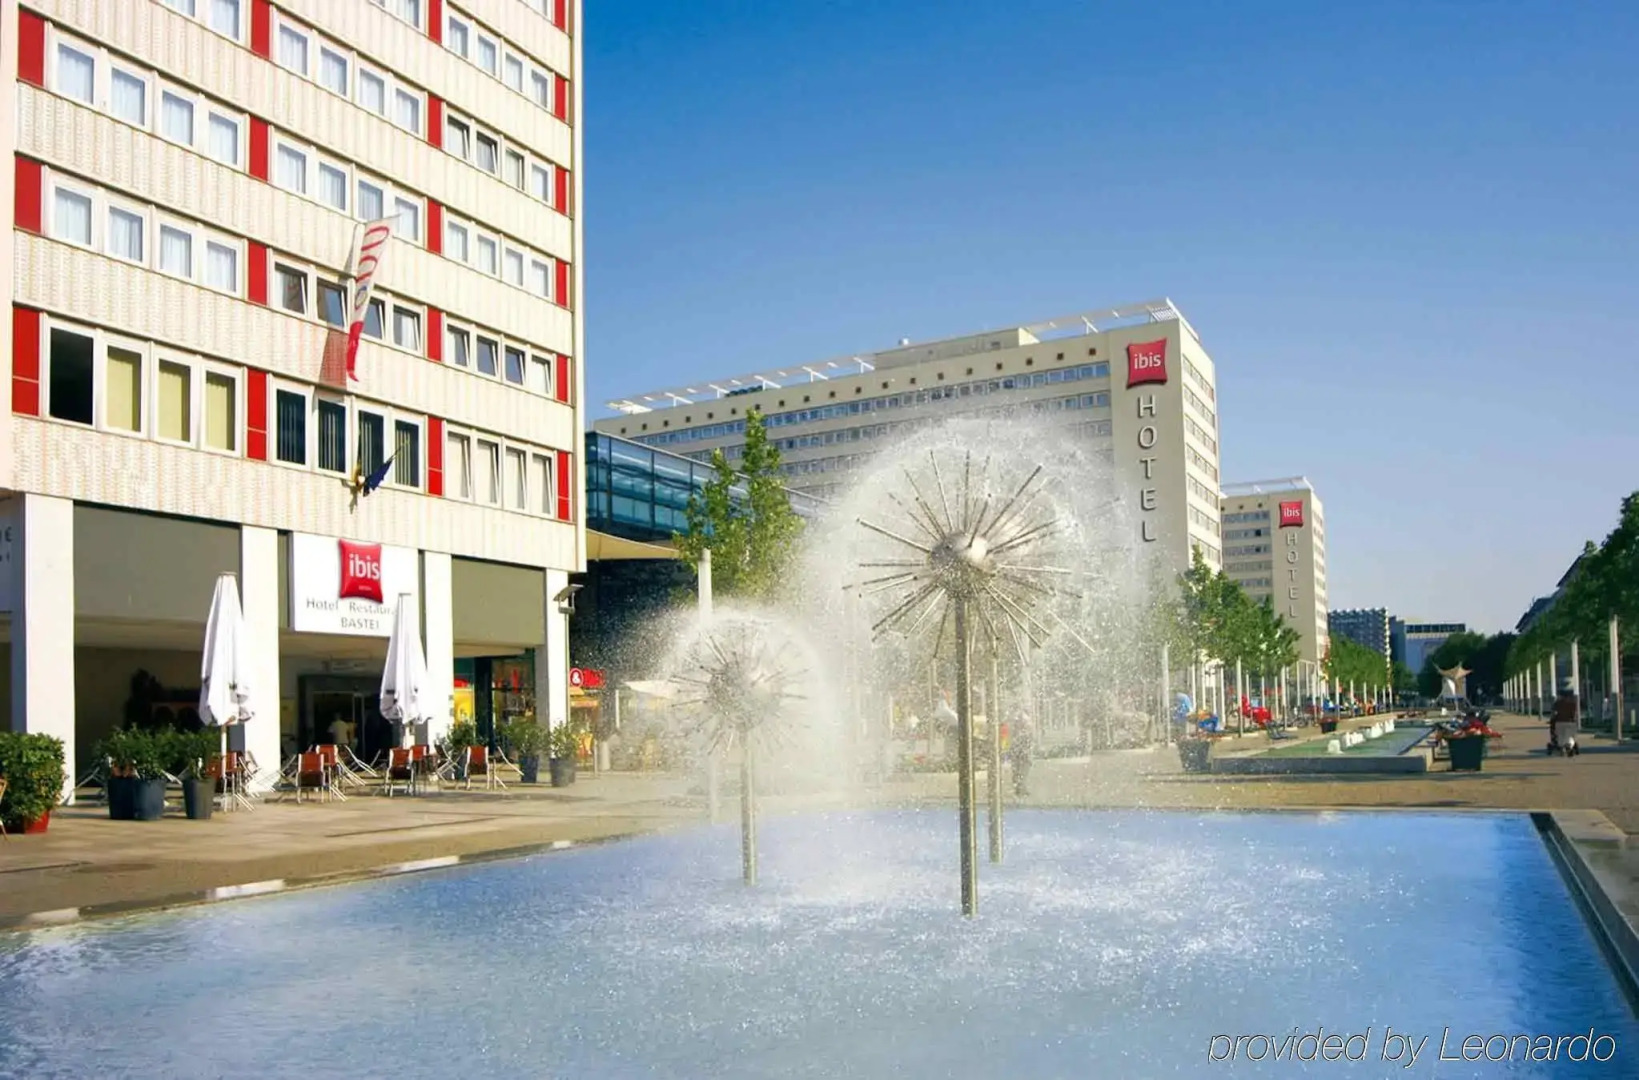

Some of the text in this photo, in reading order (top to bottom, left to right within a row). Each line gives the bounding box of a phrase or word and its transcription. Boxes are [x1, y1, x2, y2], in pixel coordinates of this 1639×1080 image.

[1134, 352, 1161, 369] ibis
[1137, 394, 1158, 542] HOTEL
[1283, 506, 1300, 517] ibis
[349, 553, 380, 580] ibis
[1285, 532, 1299, 619] HOTEL
[306, 597, 339, 611] Hotel
